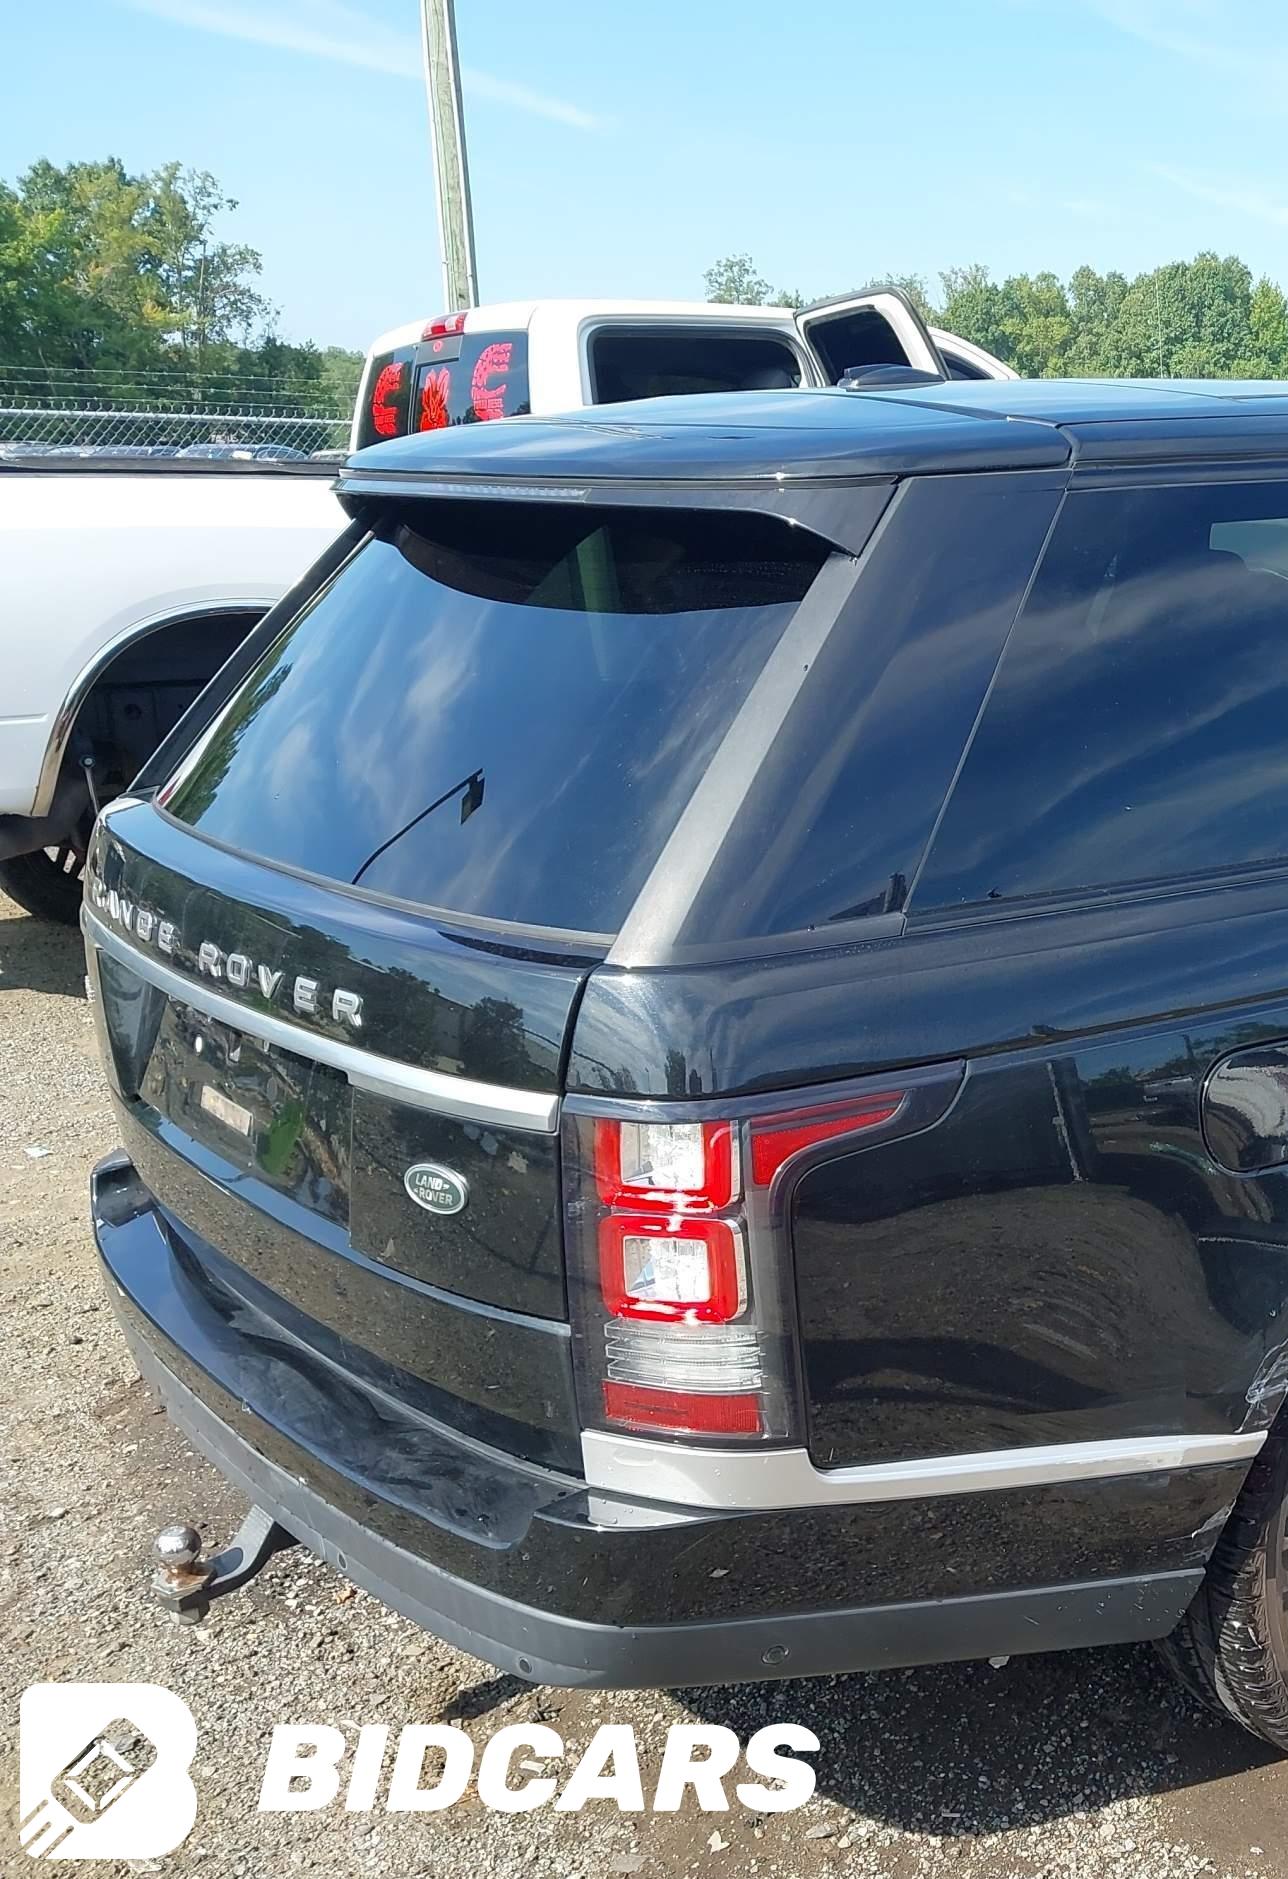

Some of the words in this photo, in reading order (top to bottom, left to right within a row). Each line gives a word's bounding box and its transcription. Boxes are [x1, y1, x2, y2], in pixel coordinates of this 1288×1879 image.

[199, 941, 364, 1027] ROVER
[415, 1173, 443, 1191] LAND
[419, 1187, 453, 1206] ROVER
